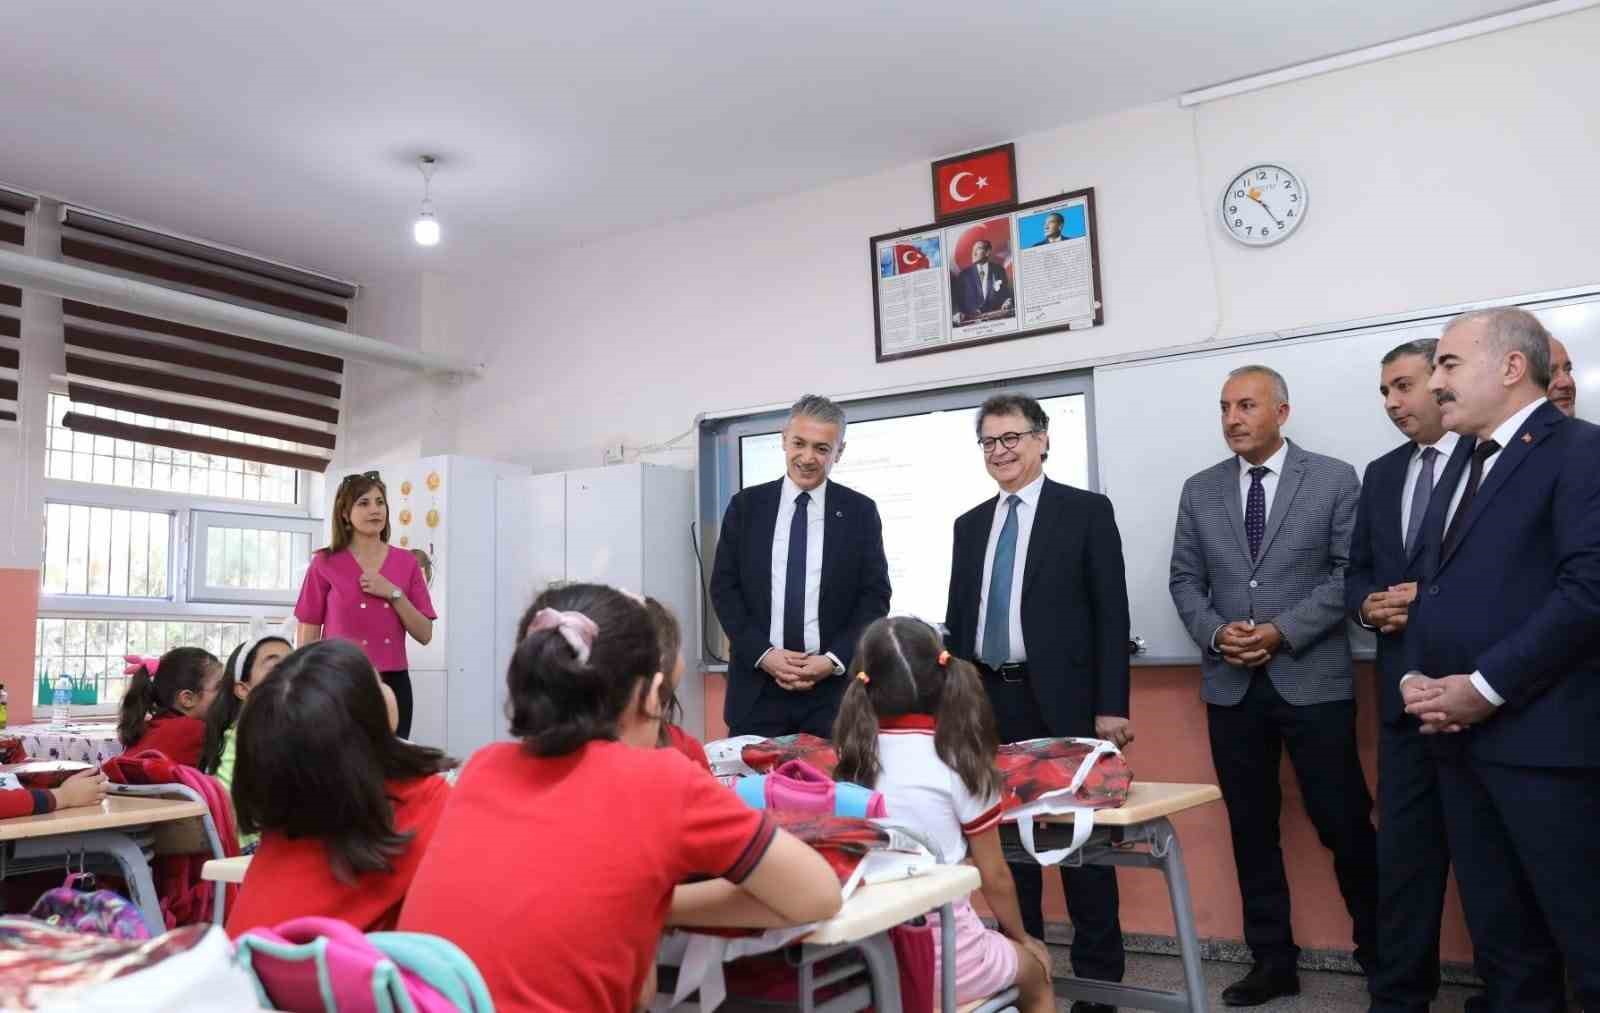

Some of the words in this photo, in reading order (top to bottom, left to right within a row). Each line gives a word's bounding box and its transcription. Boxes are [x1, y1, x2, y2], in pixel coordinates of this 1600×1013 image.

[1256, 172, 1266, 180] 12
[1244, 178, 1250, 188] 11
[1284, 180, 1292, 189] 2
[1234, 190, 1245, 200] 10
[1289, 194, 1297, 202] 3
[1229, 206, 1237, 214] 9
[1234, 219, 1243, 227] 8
[1277, 220, 1284, 229] 5
[1245, 226, 1252, 235] 7
[1261, 227, 1269, 236] 6
